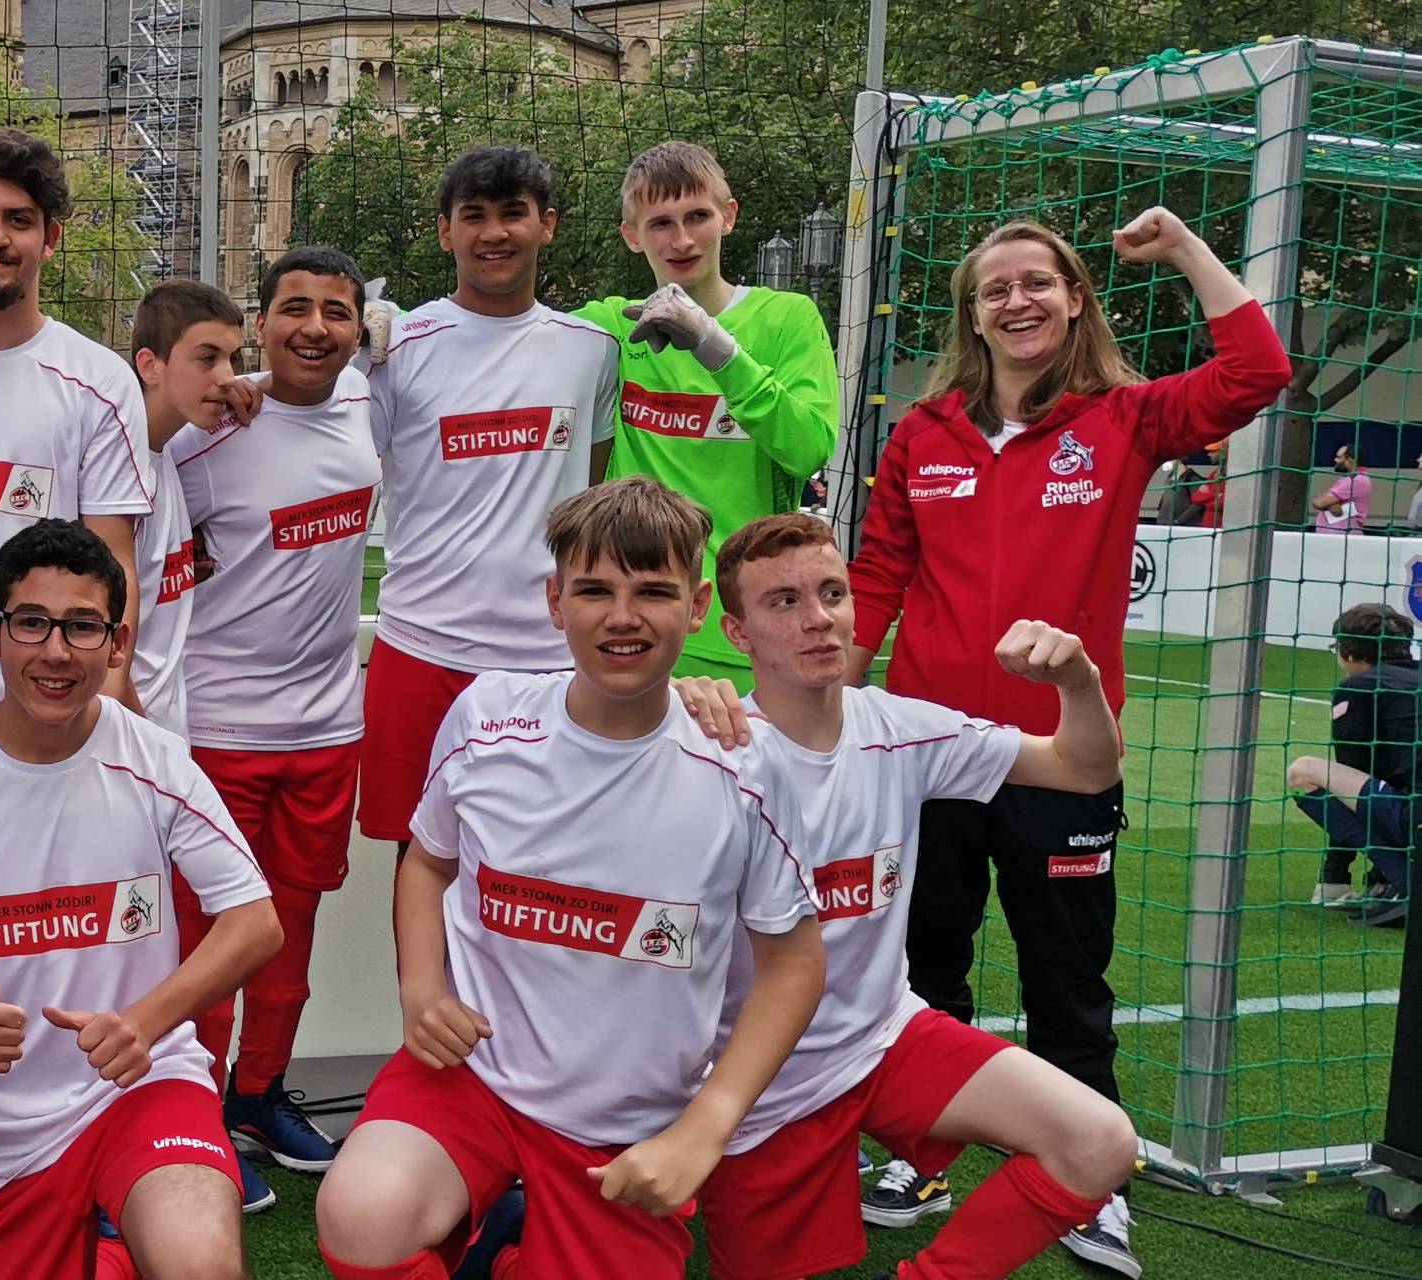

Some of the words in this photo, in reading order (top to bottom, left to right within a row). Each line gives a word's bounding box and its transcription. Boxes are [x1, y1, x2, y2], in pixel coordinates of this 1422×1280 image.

[622, 400, 702, 431] STIFTUNG
[447, 427, 539, 452] STIFTUNG
[919, 464, 975, 476] uhlsport
[909, 487, 952, 498] STIFTUNG
[1046, 478, 1094, 495] Rhein
[1041, 488, 1103, 508] Energie
[279, 509, 362, 542] STIFTUNG
[1051, 863, 1097, 874] STIFTUNG
[13, 902, 53, 916] STONN
[72, 895, 96, 908] DIR!
[490, 881, 517, 897] MER
[521, 887, 565, 908] STONN
[591, 900, 618, 916] DIR!
[482, 893, 616, 944] STIFTUNG
[153, 1136, 226, 1159] uhlsport
